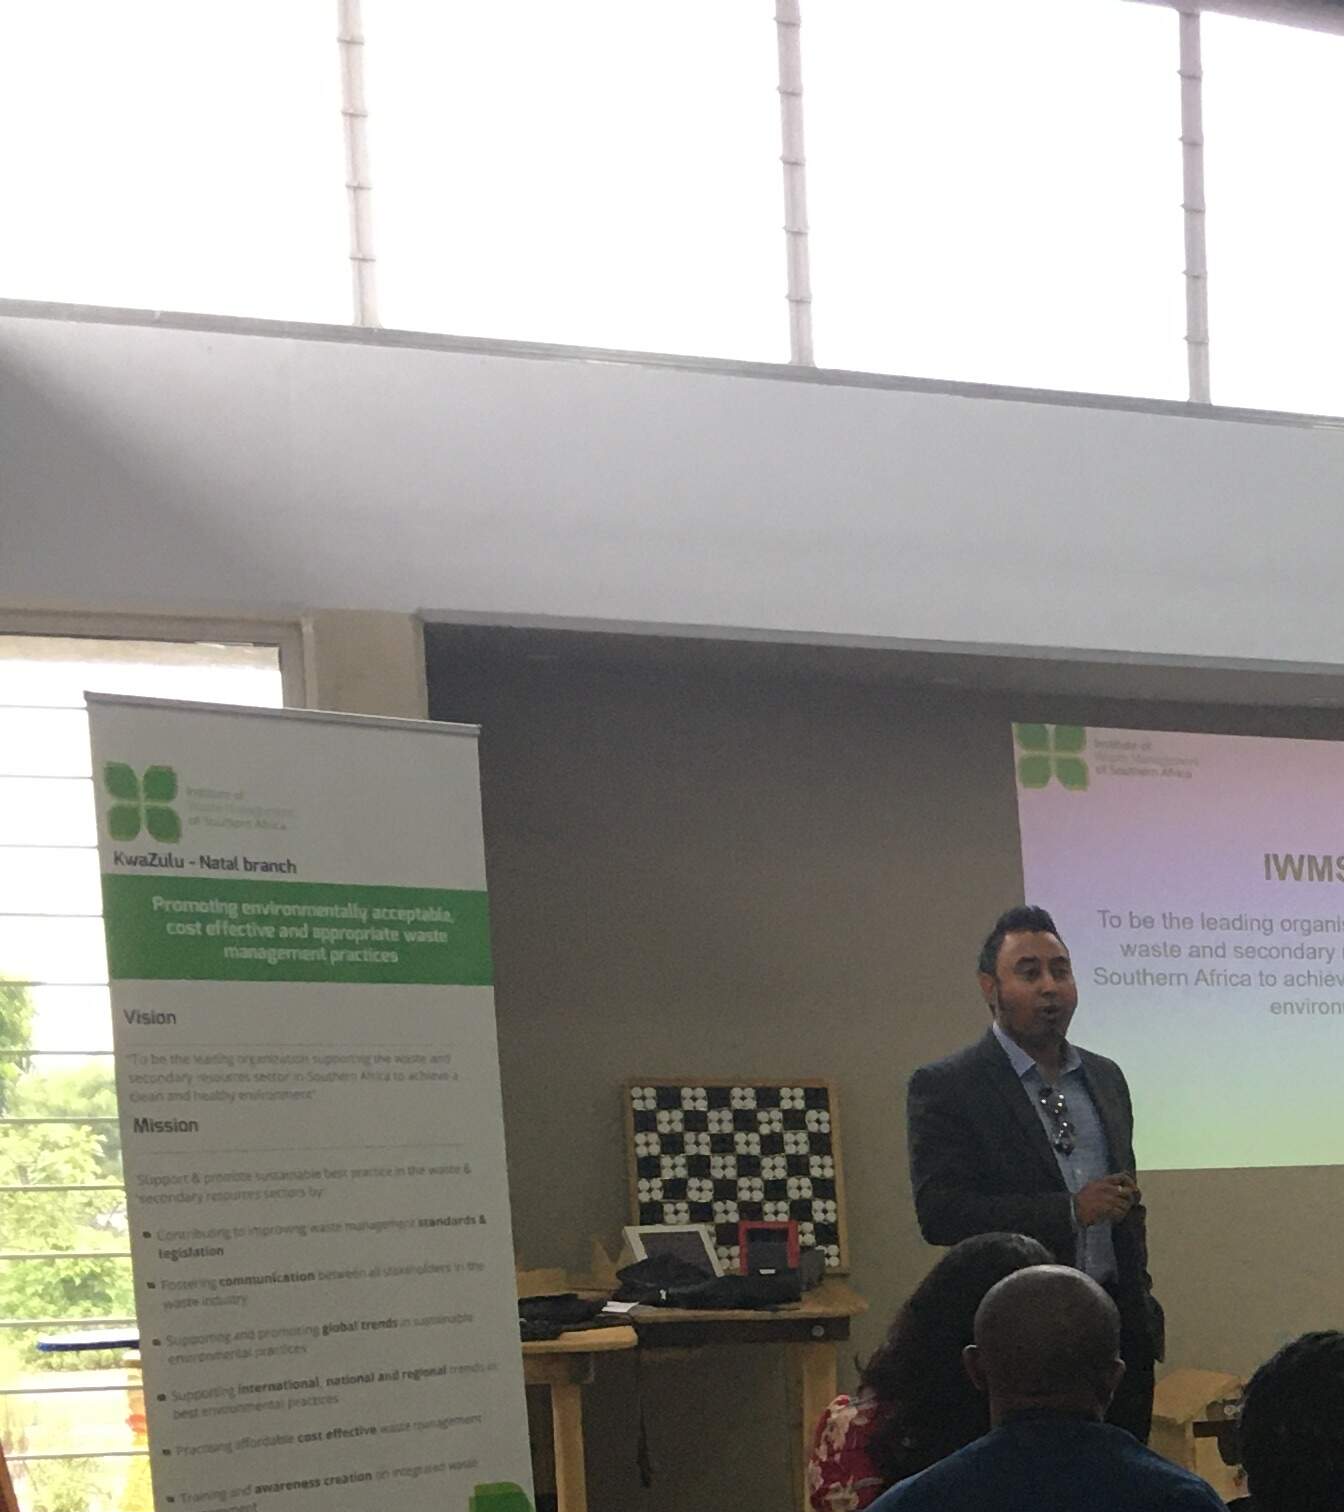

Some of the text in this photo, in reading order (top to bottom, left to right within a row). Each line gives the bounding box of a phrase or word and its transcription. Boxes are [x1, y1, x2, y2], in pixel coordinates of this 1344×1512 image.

[114, 851, 184, 869] KwaZulu
[200, 856, 240, 872] Natal
[244, 857, 297, 874] branch
[152, 898, 453, 924] Promoting environmentally acceptable,
[166, 922, 448, 943] cost effective and appropriate waste
[1098, 910, 1122, 930] To
[1130, 910, 1155, 930] be
[1162, 911, 1194, 931] the
[1200, 912, 1273, 937] leading
[224, 946, 398, 966] management practices
[1120, 941, 1181, 960] waste
[1188, 941, 1226, 959] and
[1233, 942, 1335, 964] secondary
[1093, 968, 1189, 987] Southern
[1194, 969, 1252, 987] Africa
[1258, 970, 1277, 988] to
[123, 1009, 177, 1025] Vision
[133, 1118, 199, 1134] Mission
[418, 1214, 476, 1228] standards
[158, 1245, 224, 1262] legislation
[219, 1271, 315, 1288] communication
[361, 1318, 398, 1331] trends
[326, 1372, 375, 1388] national
[402, 1365, 447, 1382] regional
[297, 1425, 377, 1443] cost effective
[254, 1471, 373, 1495] awareness creation
